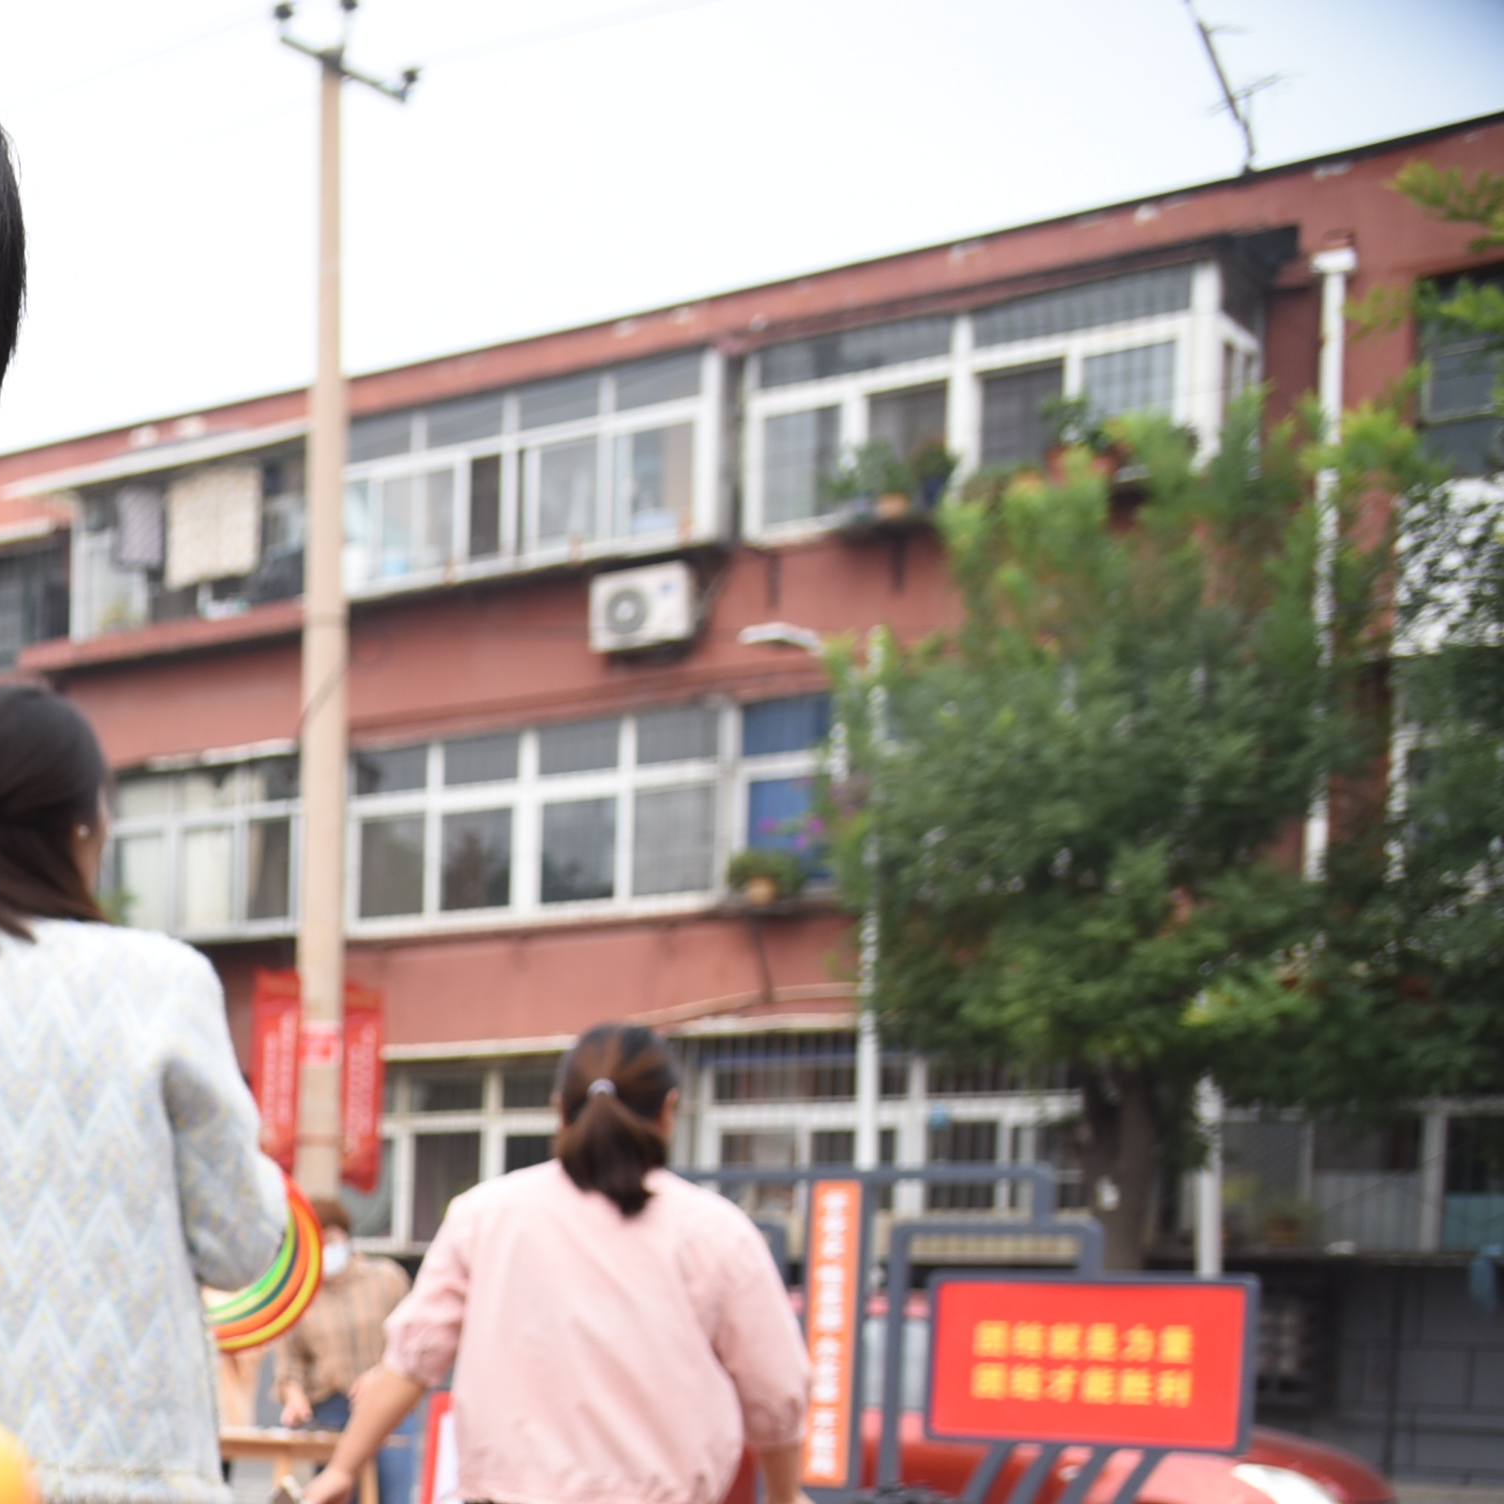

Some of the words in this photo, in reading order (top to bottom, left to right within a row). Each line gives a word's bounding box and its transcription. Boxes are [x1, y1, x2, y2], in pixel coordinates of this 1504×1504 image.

[973, 1320, 1194, 1364] 团结就是力量
[971, 1363, 1192, 1408] 团结才能胜利
